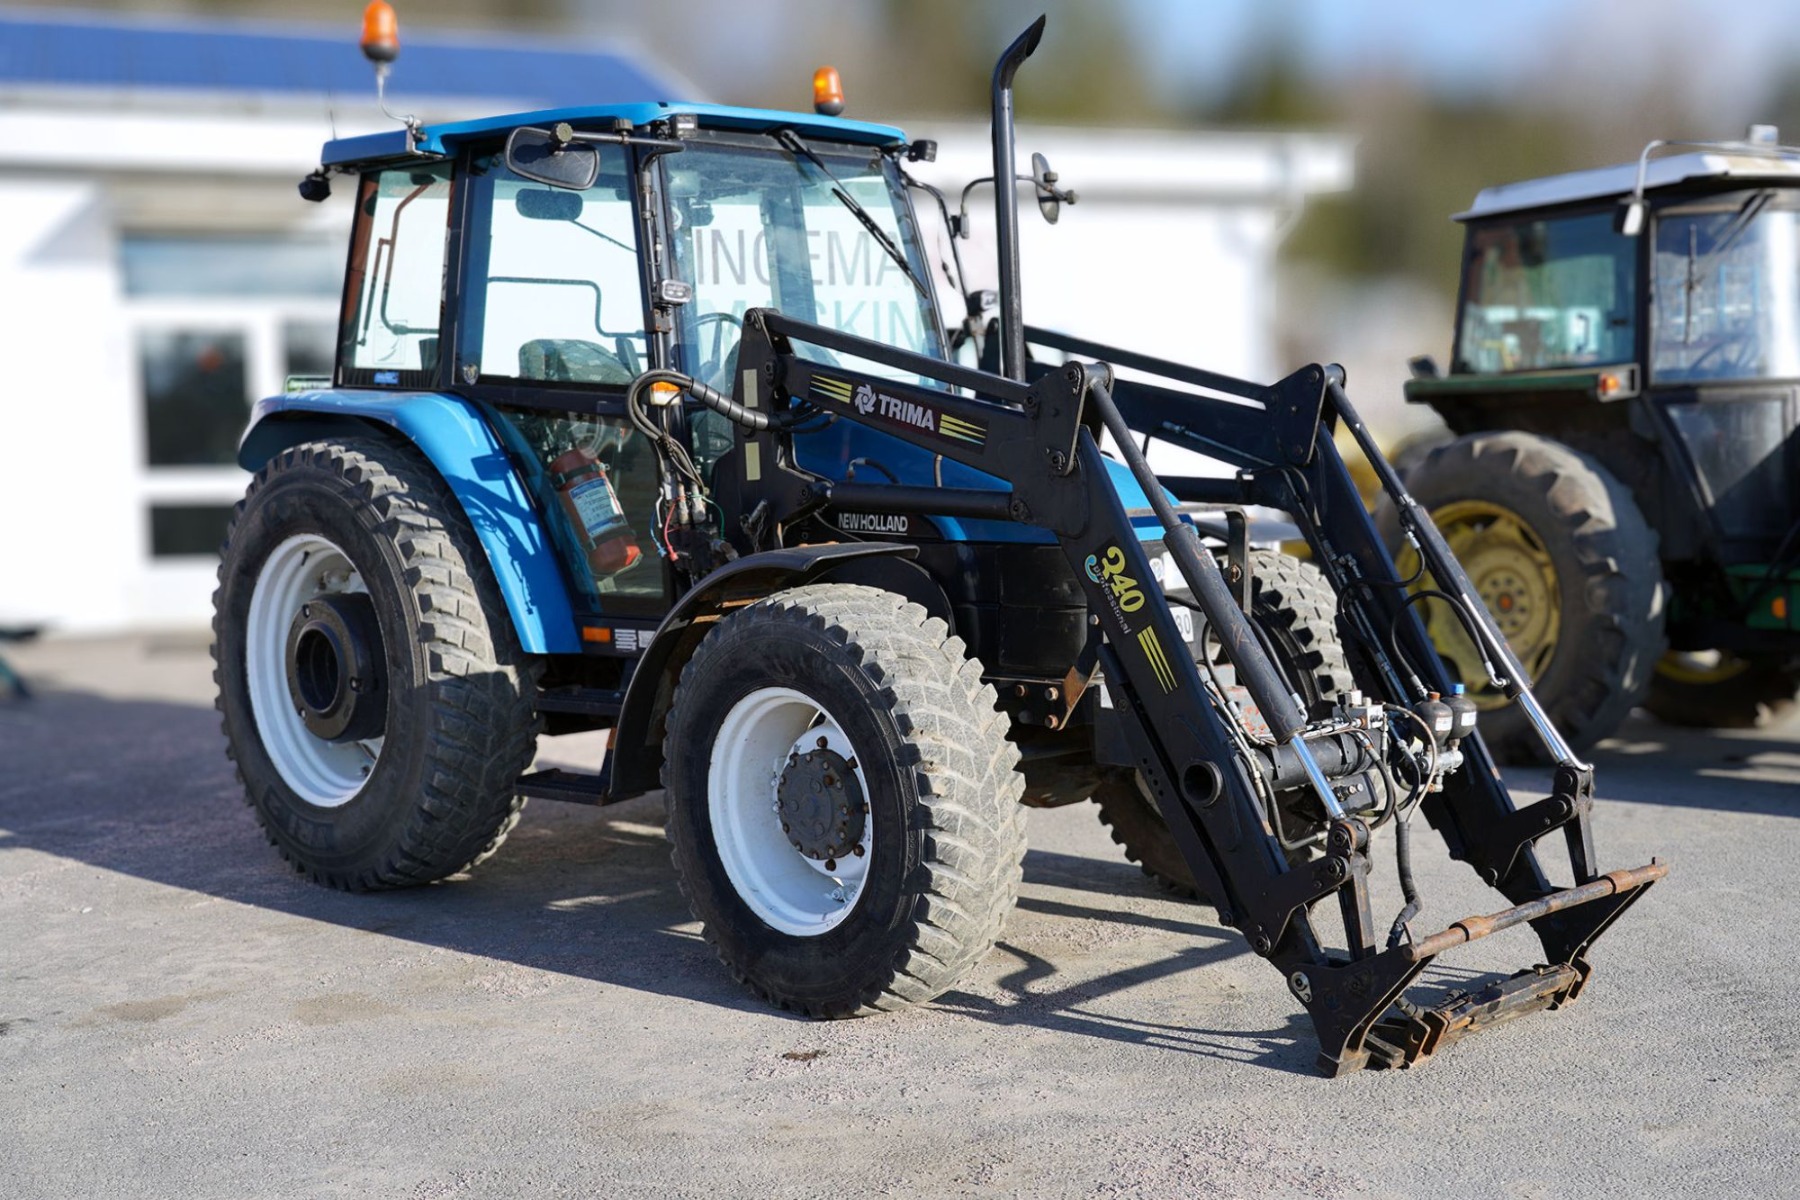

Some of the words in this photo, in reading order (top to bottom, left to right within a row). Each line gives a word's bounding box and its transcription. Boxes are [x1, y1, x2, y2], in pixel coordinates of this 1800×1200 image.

[878, 393, 935, 432] TRIMA
[838, 512, 860, 530] NEW
[860, 513, 909, 533] HOLLAND
[1101, 545, 1146, 613] 340
